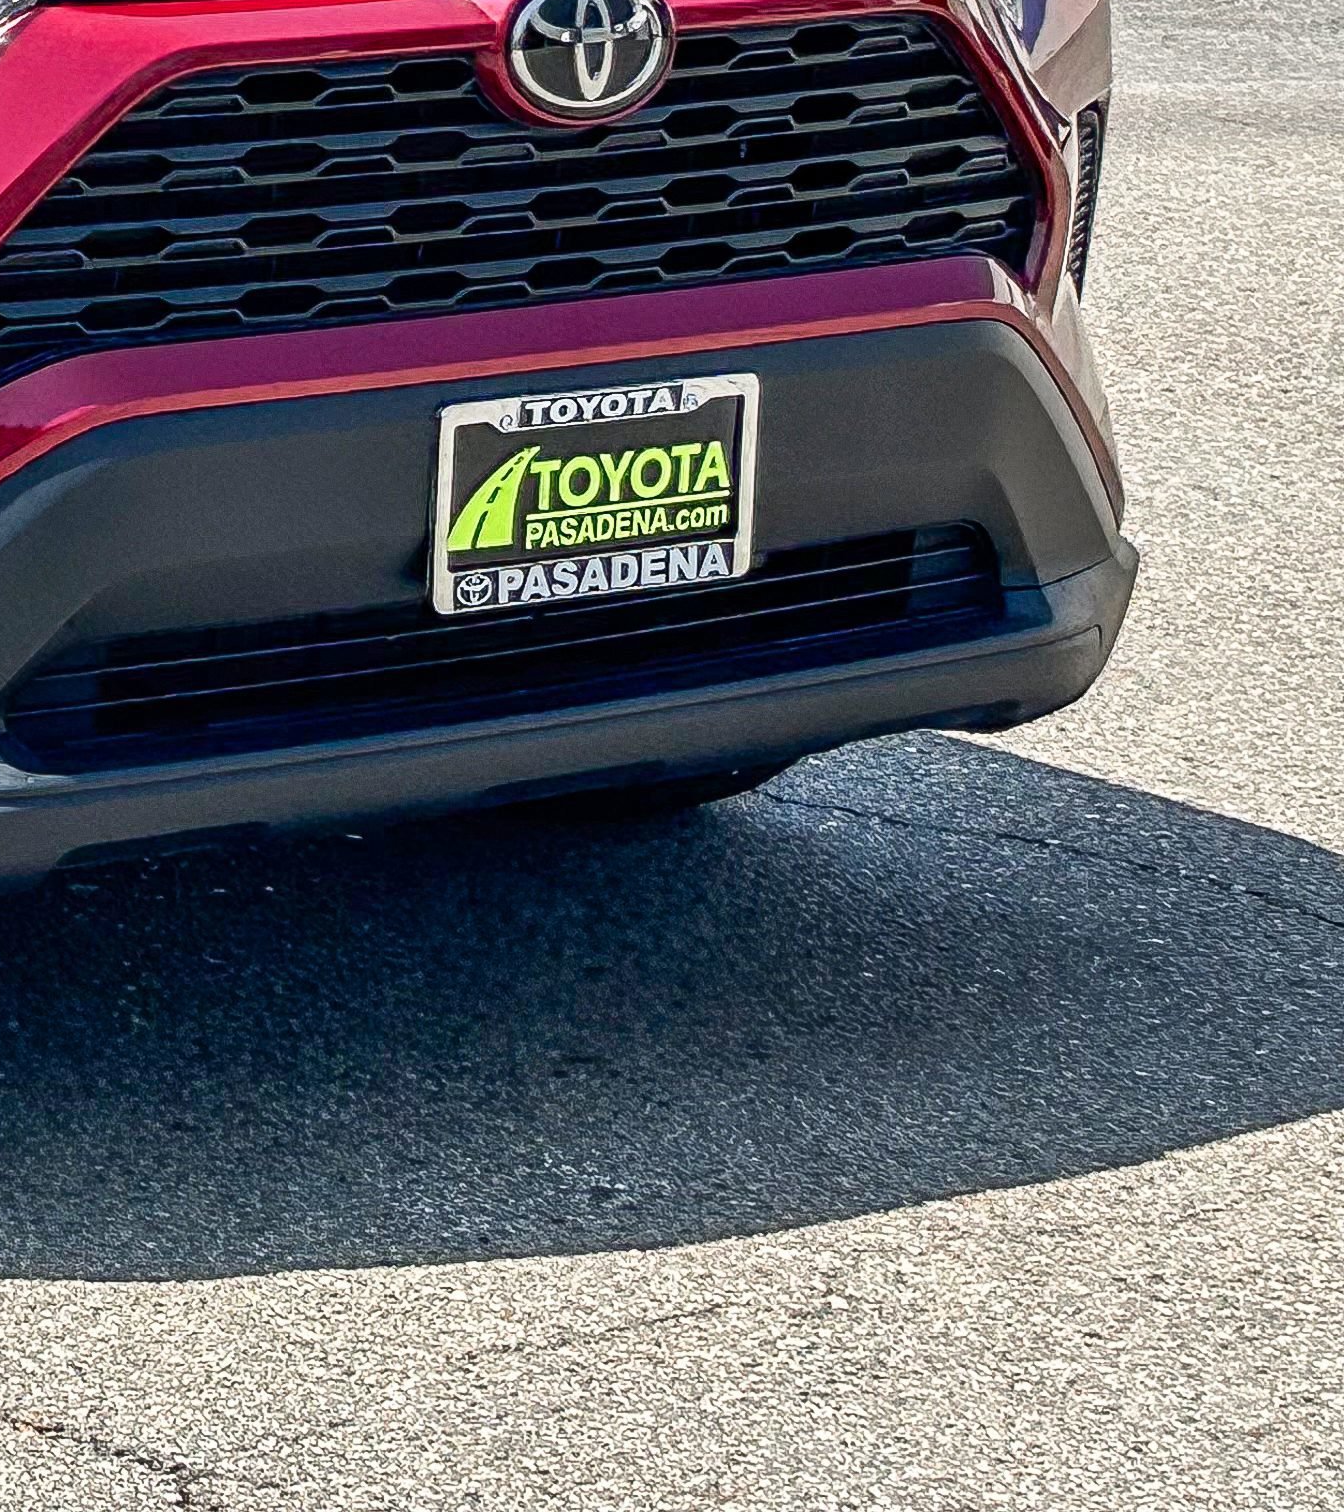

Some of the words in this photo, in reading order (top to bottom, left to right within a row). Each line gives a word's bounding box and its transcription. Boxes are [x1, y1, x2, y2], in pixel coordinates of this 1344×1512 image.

[524, 388, 676, 426] TOYOTA
[528, 440, 731, 511] TOYOTA
[524, 502, 729, 550] PASADENA.com
[497, 544, 730, 604] PASADENA
